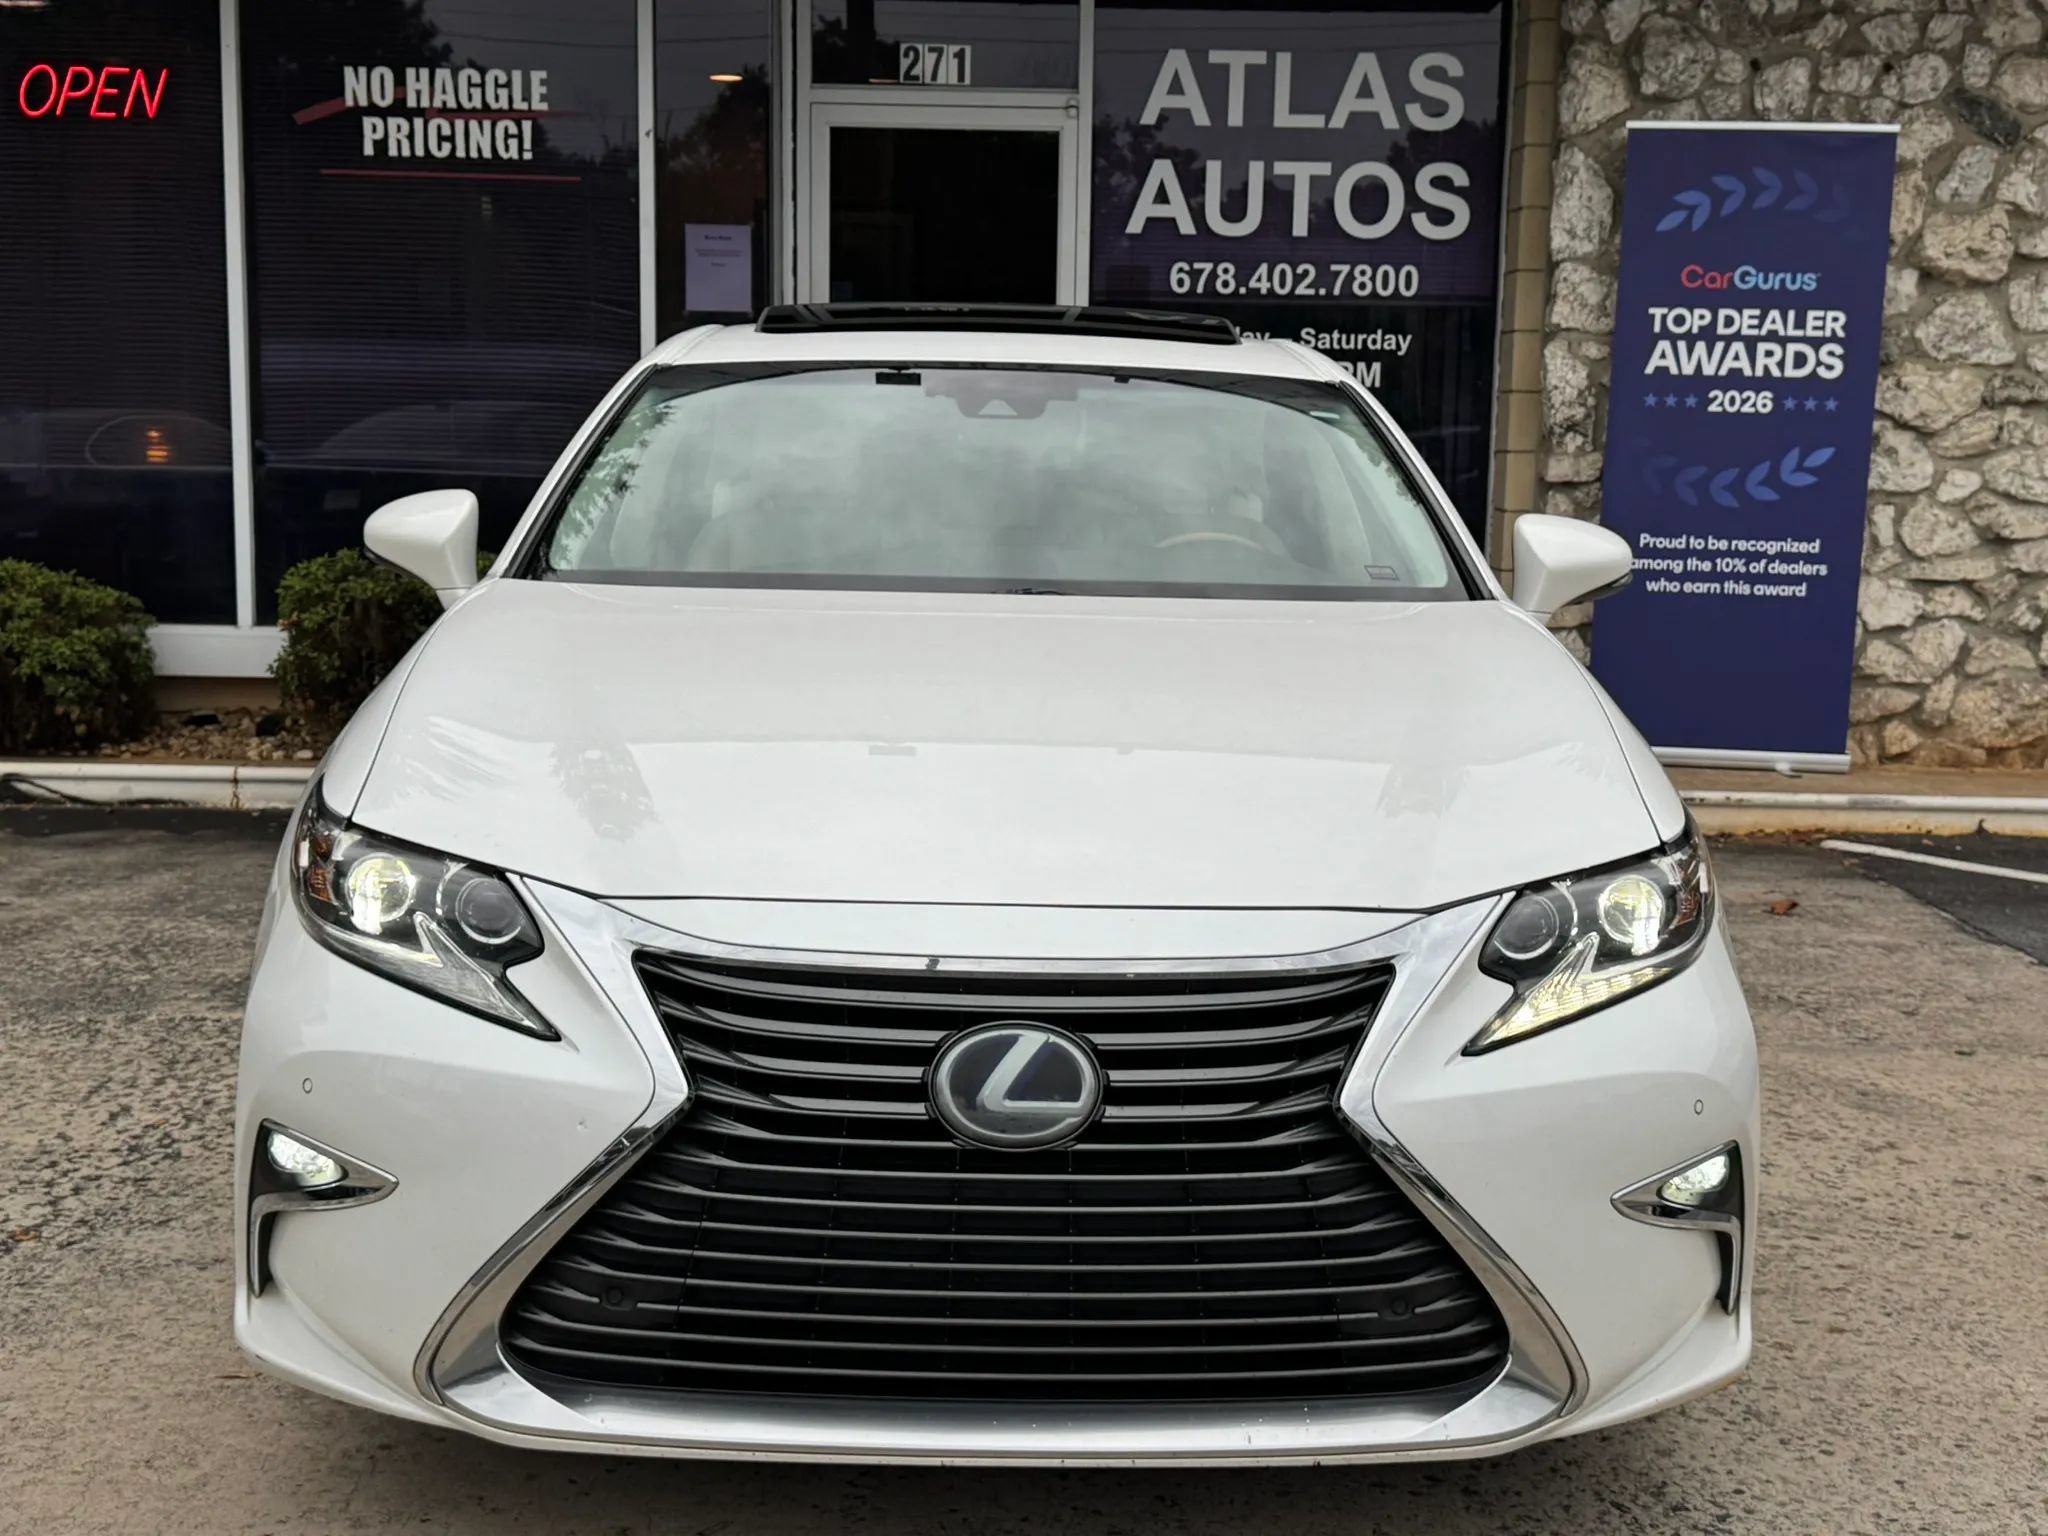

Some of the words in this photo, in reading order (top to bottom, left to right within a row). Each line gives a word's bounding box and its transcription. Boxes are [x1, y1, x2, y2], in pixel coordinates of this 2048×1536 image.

[902, 45, 966, 83] 271
[19, 64, 168, 119] OPEN
[343, 66, 394, 108] NO
[406, 68, 549, 111] HAGGLE
[1139, 49, 1466, 132] ATLAS
[362, 117, 533, 160] PRICING!
[1125, 158, 1471, 241] AUTOS
[1169, 262, 1420, 298] 678.402.7800
[1680, 264, 1818, 291] CarGurus
[1648, 307, 1712, 334] TOP
[1716, 308, 1847, 338] DEALER
[1300, 327, 1412, 356] Saturday
[1644, 340, 1845, 379] AWARDS
[1707, 390, 1774, 414] 2026
[1639, 533, 1686, 549] Proud
[1689, 535, 1705, 549] to
[1708, 536, 1728, 550] be
[1731, 538, 1820, 555] recognized
[1631, 558, 1683, 574] among
[1687, 557, 1712, 572] the
[1715, 558, 1746, 573] 10%
[1749, 560, 1768, 574] of
[1768, 560, 1828, 576] dealers
[1646, 578, 1680, 592] who
[1683, 582, 1720, 593] earn
[1723, 580, 1750, 595] this
[1753, 583, 1807, 597] award
